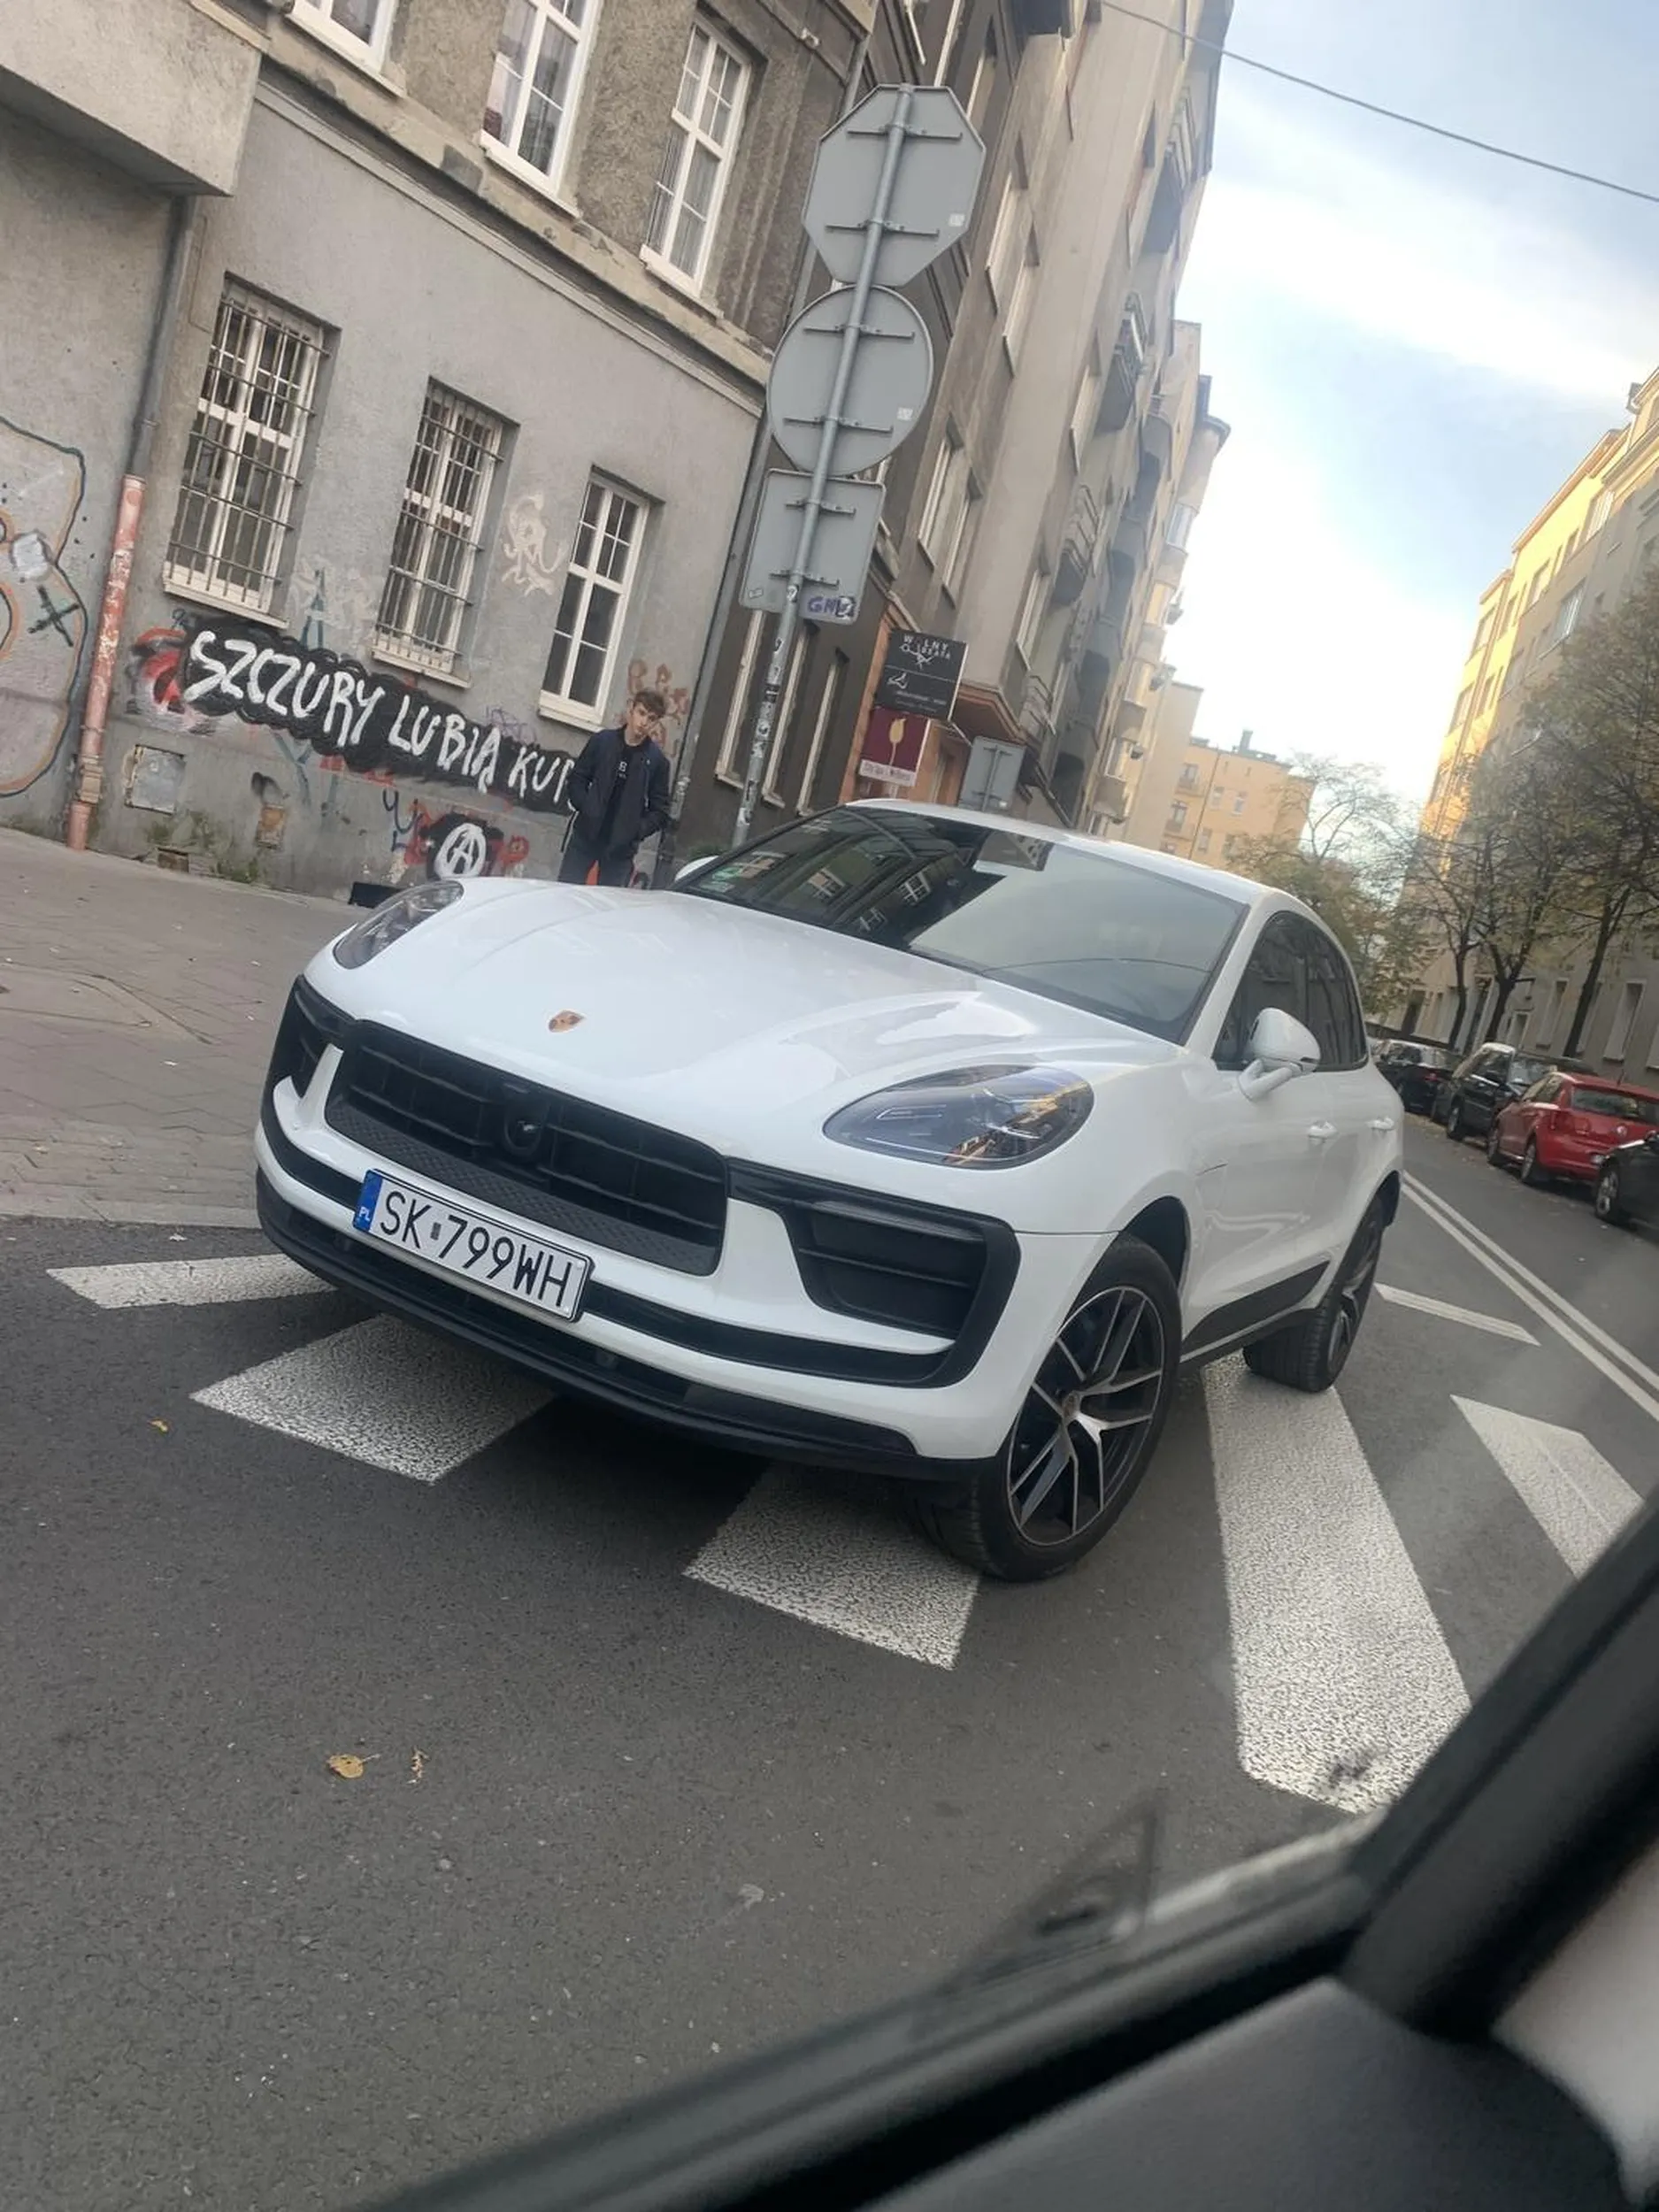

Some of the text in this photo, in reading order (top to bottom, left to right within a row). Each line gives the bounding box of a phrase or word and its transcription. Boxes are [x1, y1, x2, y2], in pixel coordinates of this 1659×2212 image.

[182, 630, 387, 748] SZCZURY
[388, 695, 502, 794] LUBIĄ
[358, 1206, 371, 1222] PL
[380, 1190, 572, 1308] SK 799WH
